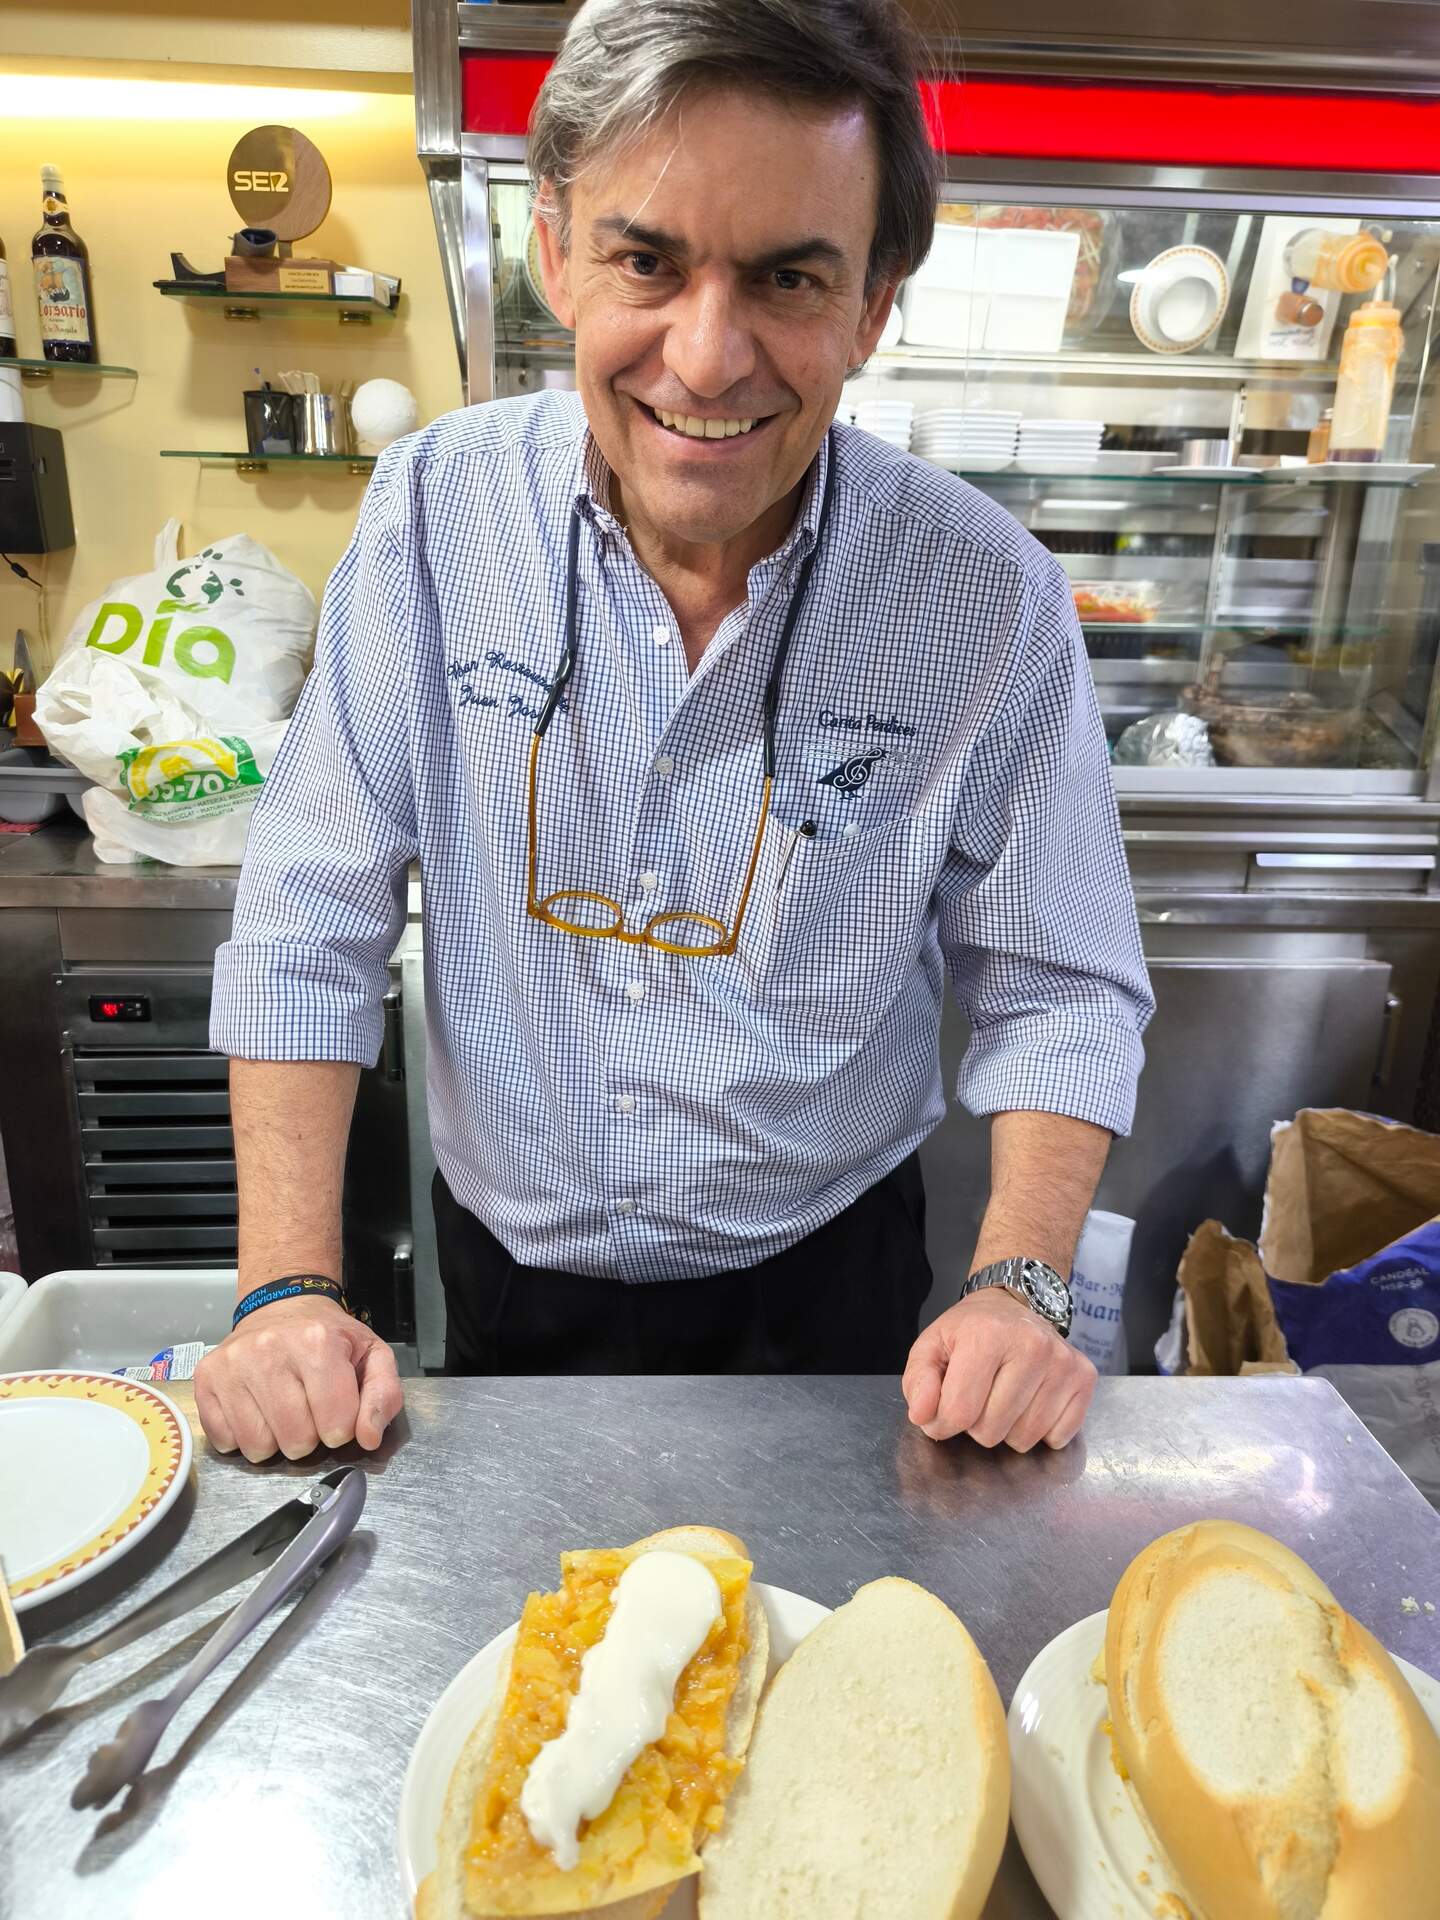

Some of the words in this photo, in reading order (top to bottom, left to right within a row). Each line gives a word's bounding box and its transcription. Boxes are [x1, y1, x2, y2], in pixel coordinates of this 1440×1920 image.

[485, 651, 569, 713] Restaurate
[459, 684, 499, 707] Juan
[508, 695, 541, 719] Jos
[243, 1285, 302, 1313] GUARDIANES
